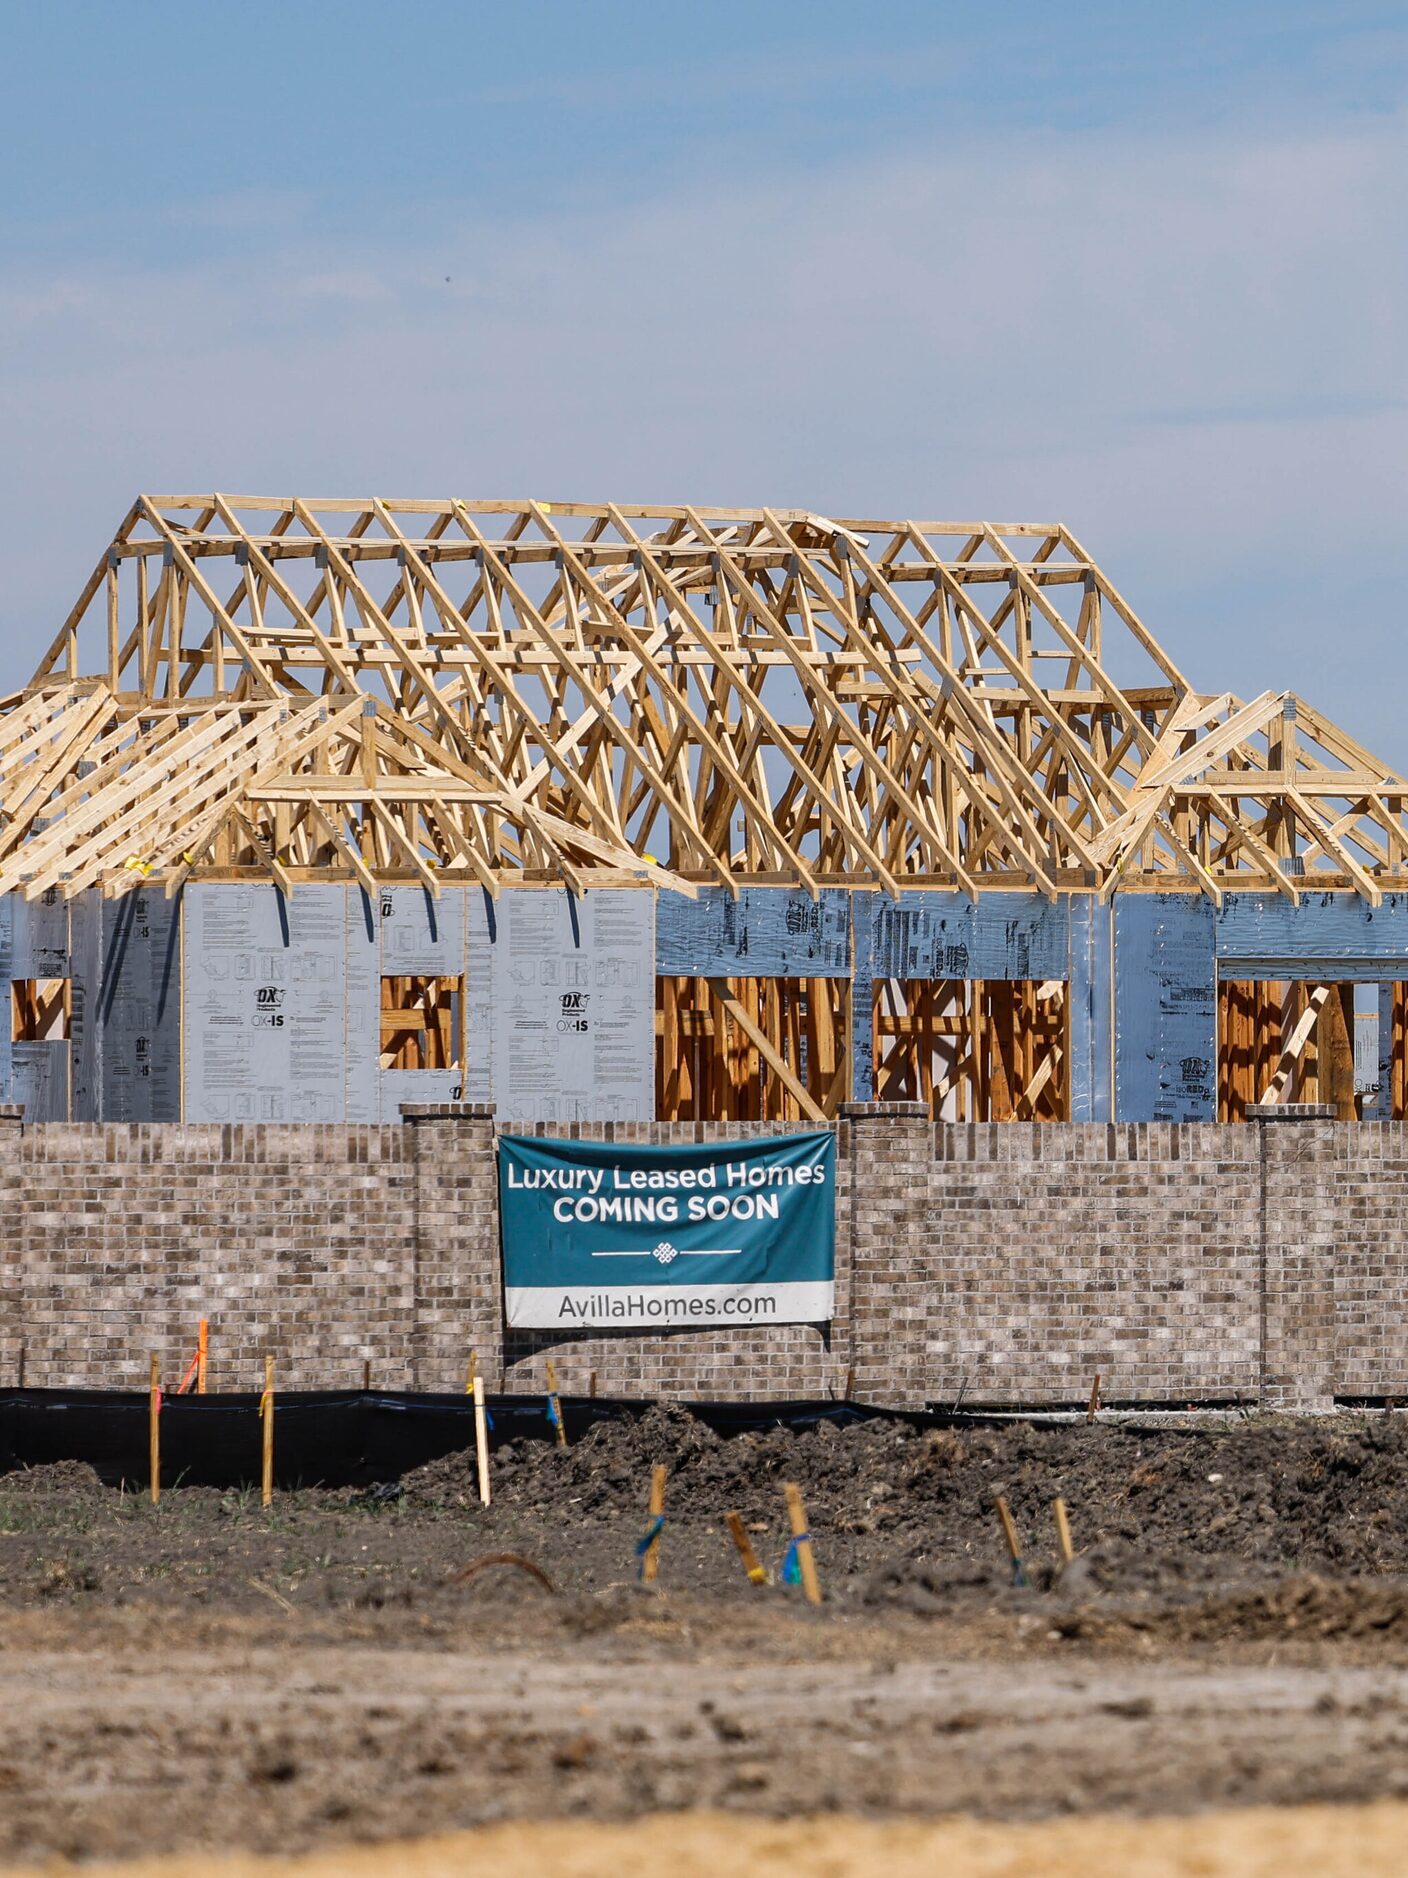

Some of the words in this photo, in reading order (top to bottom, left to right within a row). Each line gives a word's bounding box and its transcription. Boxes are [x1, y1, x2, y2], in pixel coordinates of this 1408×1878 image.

[251, 1014, 284, 1027] OX-IS
[556, 1020, 588, 1032] OX-IS
[508, 1163, 604, 1195] Luxury
[613, 1163, 716, 1190] Leased
[726, 1162, 825, 1187] Homes
[553, 1197, 679, 1223] COMING
[688, 1194, 779, 1221] SOON
[559, 1295, 776, 1318] AvillaHomes.com
